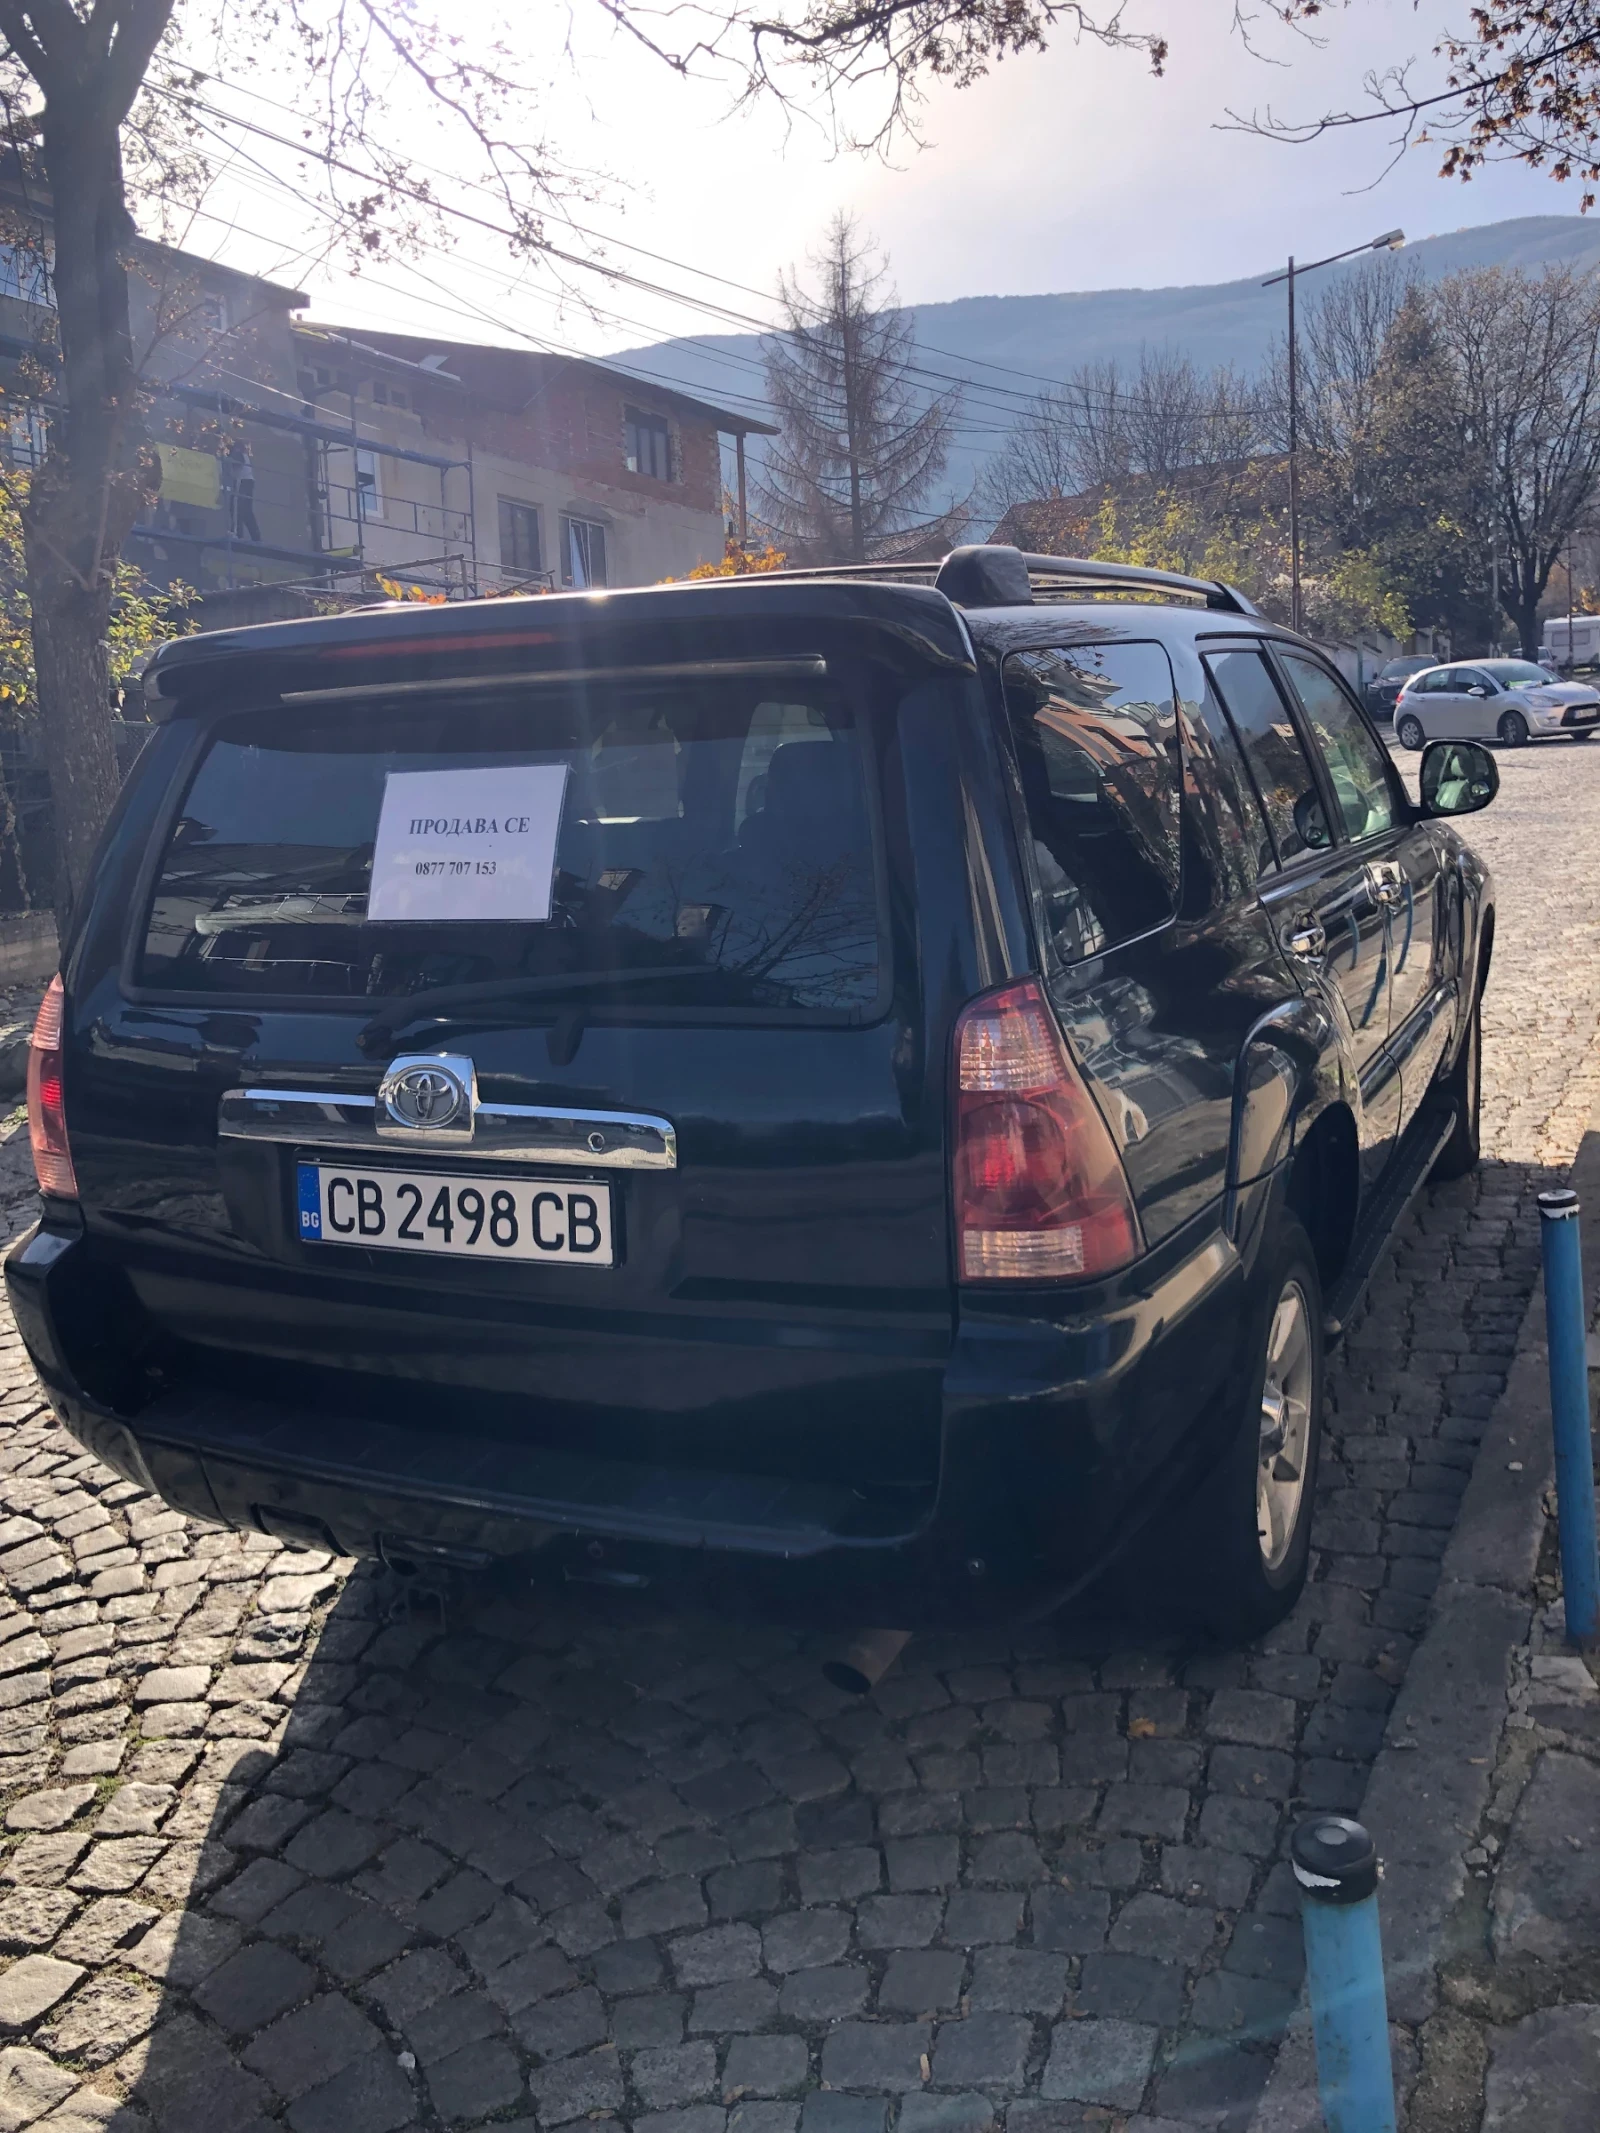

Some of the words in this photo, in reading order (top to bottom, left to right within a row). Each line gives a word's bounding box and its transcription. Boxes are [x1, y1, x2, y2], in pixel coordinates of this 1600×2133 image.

[409, 818, 498, 837] ПРОДАВА
[504, 817, 530, 833] СЕ
[415, 862, 445, 876] 0877
[449, 862, 471, 875] 707
[475, 861, 497, 876] 153
[301, 1211, 320, 1228] BG
[396, 1183, 519, 1248] 2498
